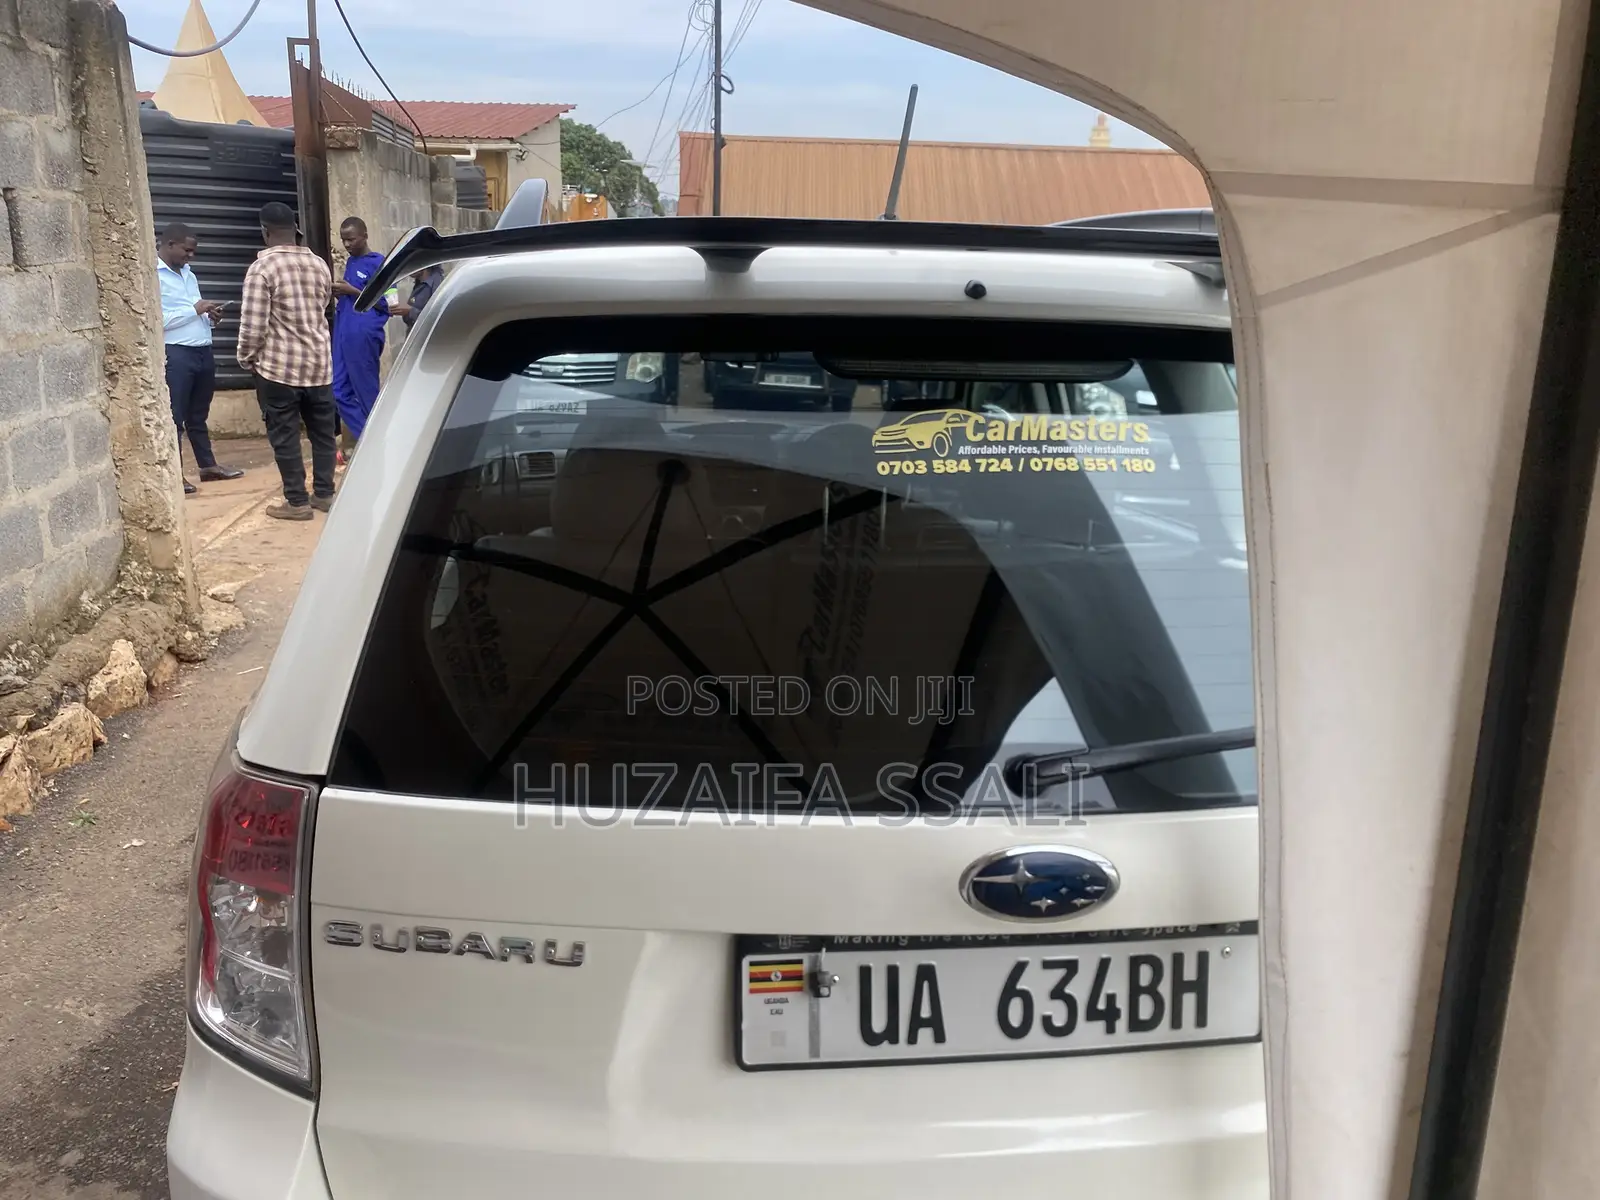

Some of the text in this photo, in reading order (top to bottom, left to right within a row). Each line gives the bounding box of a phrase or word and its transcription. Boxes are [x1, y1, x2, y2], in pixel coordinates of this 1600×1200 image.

[965, 414, 1151, 443] CarMasters
[958, 443, 1150, 456] Affordable Prices, Favourable Installments
[876, 458, 1156, 476] 0703 584 724 / 0768 551 180
[323, 919, 586, 968] SUBARU
[858, 950, 1209, 1047] UA 634BH
